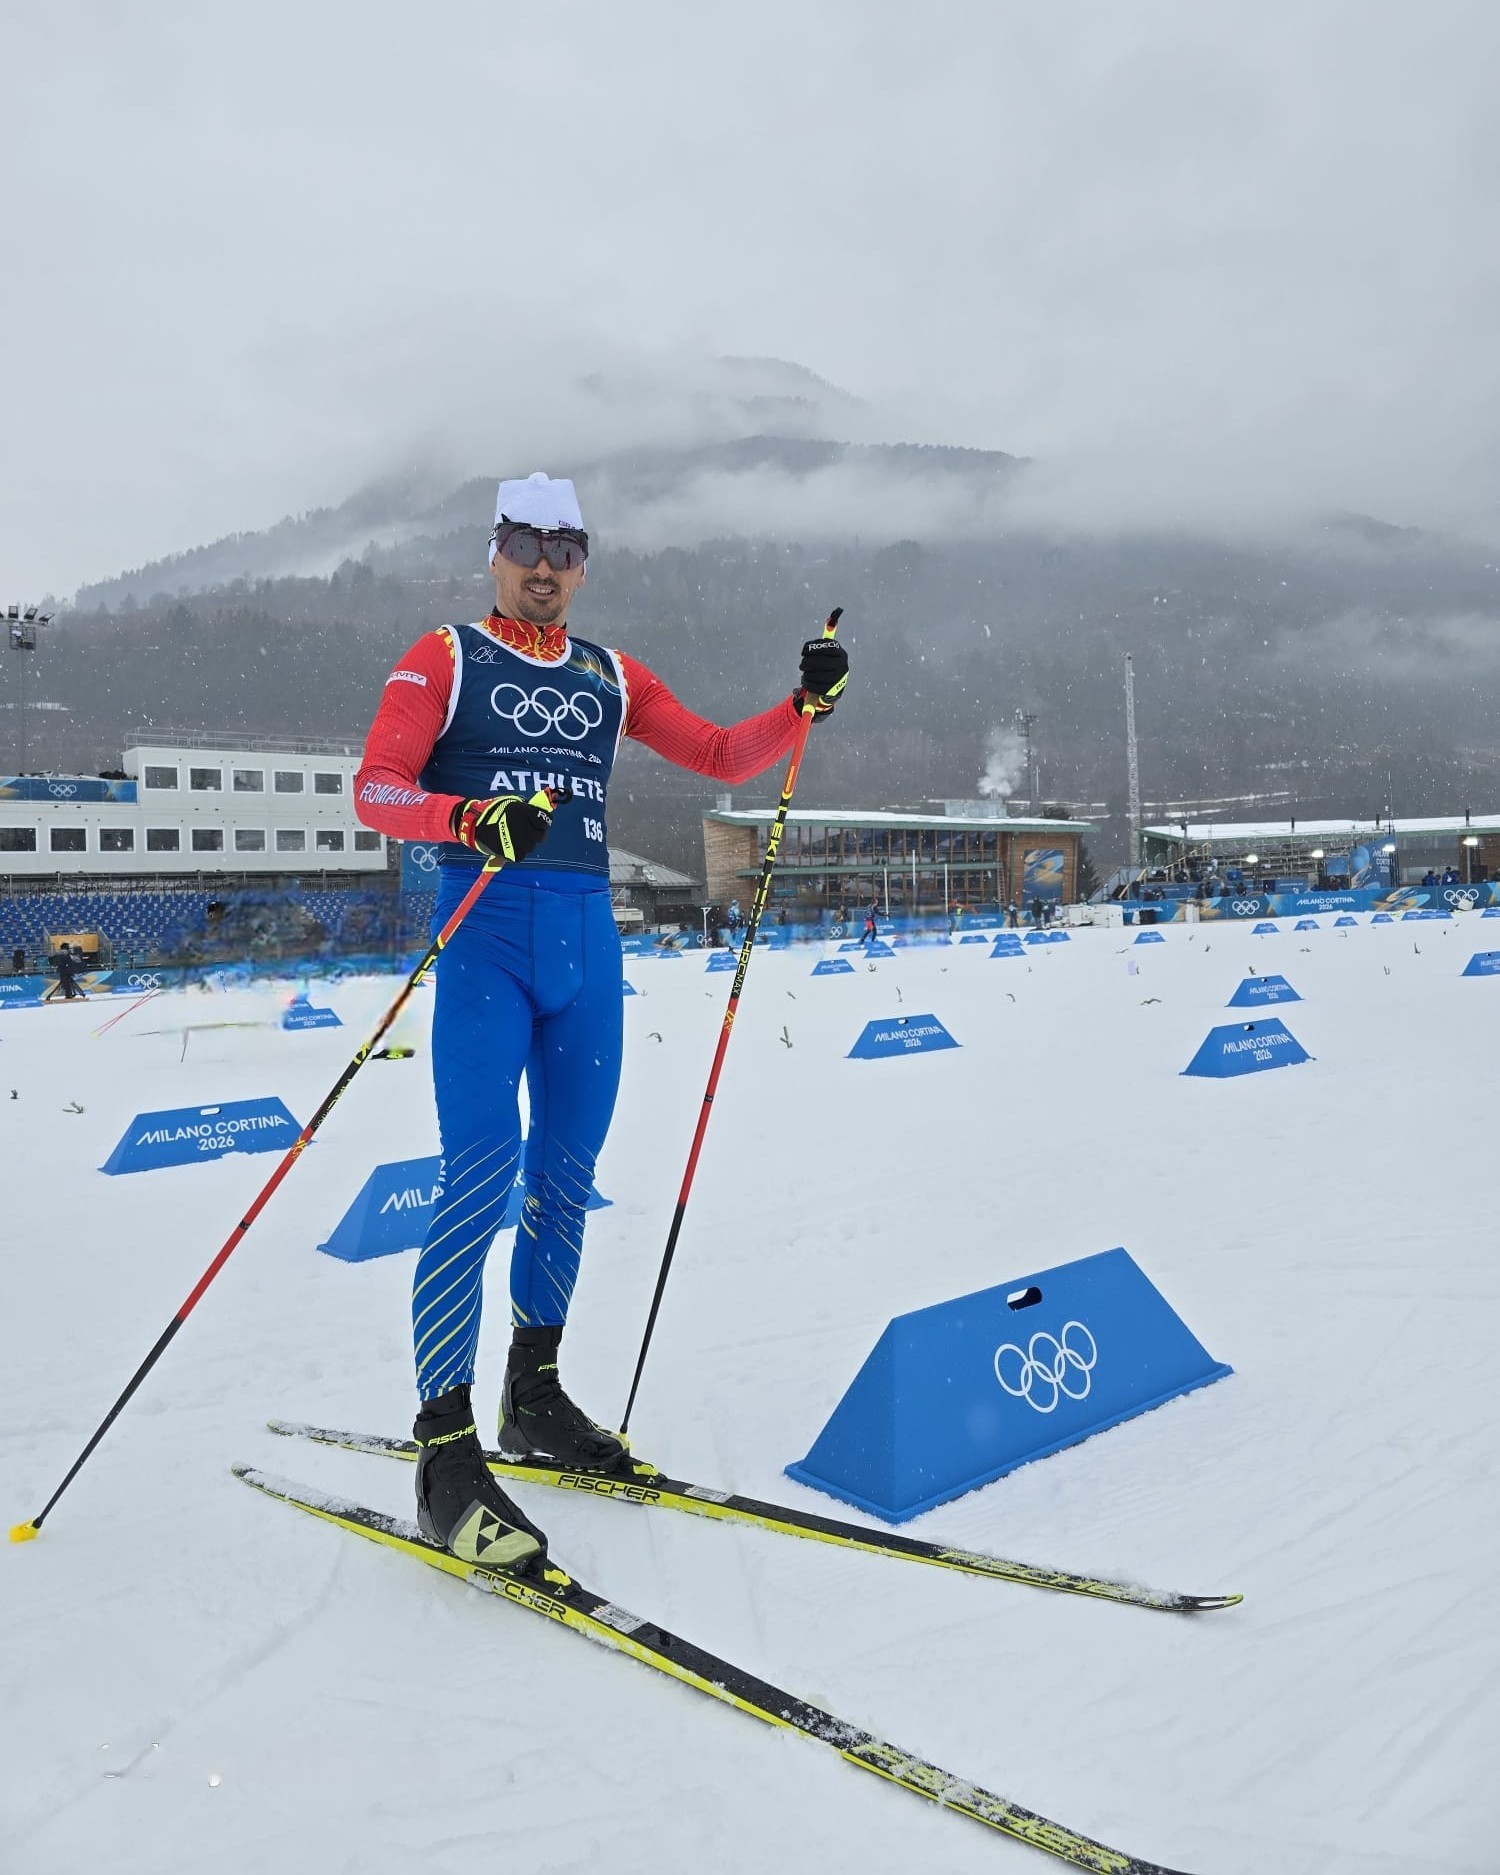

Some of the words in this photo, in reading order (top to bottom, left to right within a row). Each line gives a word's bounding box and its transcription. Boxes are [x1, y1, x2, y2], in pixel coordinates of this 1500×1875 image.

[487, 746, 539, 754] MILANO
[359, 782, 431, 805] ROMANIA
[489, 770, 604, 803] ATHLETE
[583, 817, 603, 842] 136
[765, 805, 789, 862] LEKI
[1296, 898, 1325, 906] MILANO
[1325, 896, 1356, 904] CORTINA
[875, 1030, 909, 1042] MILANO
[908, 1025, 944, 1038] CORTINA
[903, 1037, 922, 1048] 2026
[1223, 1038, 1257, 1055] MILANO
[1256, 1033, 1293, 1048] CORTINA
[1253, 1048, 1273, 1061] 2026
[136, 1124, 212, 1146] MILANO
[215, 1115, 290, 1135] CORTINA
[199, 1135, 235, 1151] 2026
[558, 1474, 661, 1503] FISCHER
